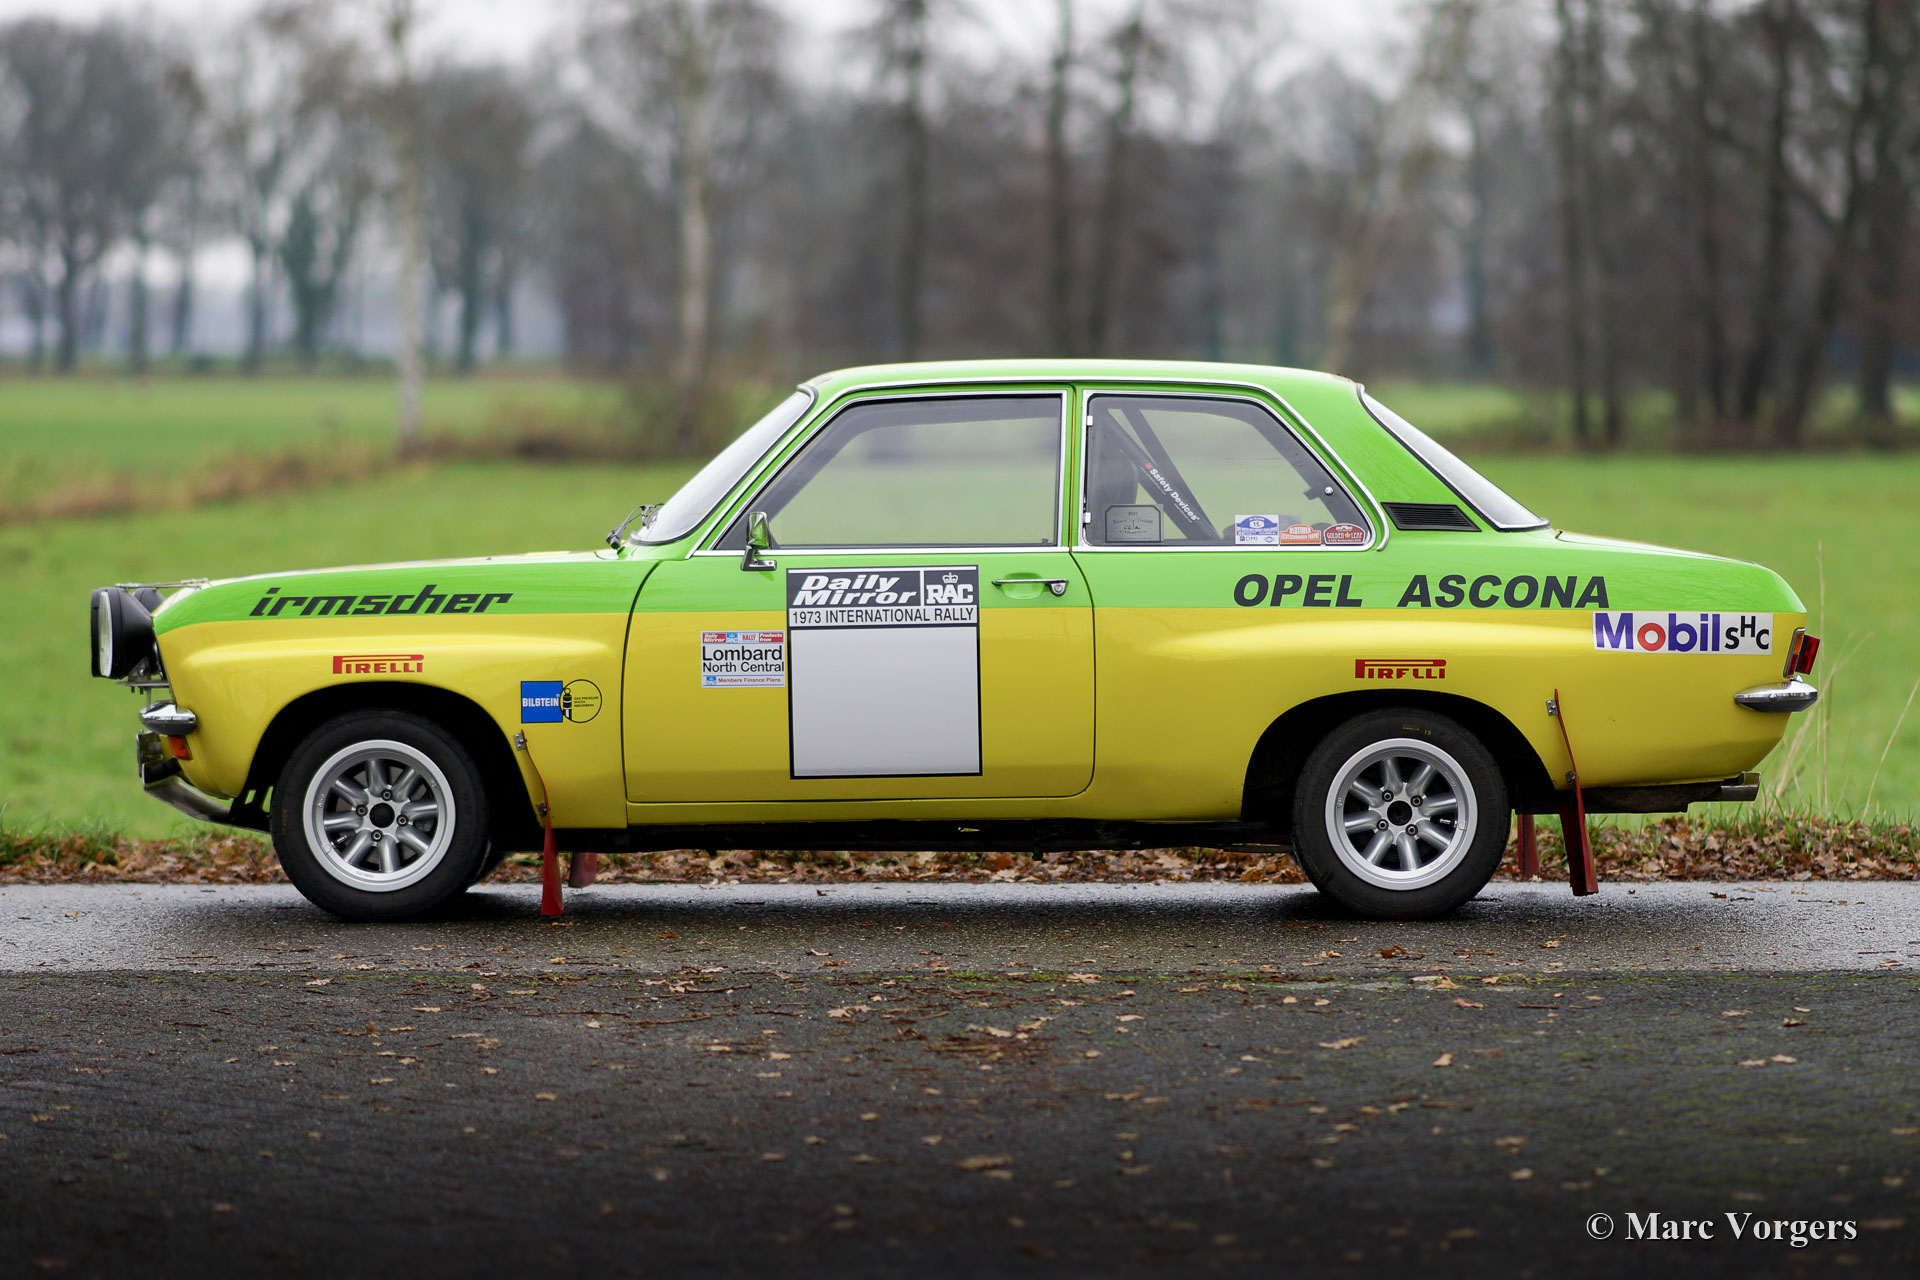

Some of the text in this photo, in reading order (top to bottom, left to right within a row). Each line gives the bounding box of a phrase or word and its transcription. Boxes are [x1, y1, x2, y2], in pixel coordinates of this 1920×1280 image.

[1150, 469, 1172, 491] Safety
[1170, 492, 1198, 520] Devices
[801, 574, 900, 593] Daily
[1233, 574, 1610, 608] OPEL ASCONA
[249, 584, 514, 616] irmscher
[792, 589, 917, 606] Mirror
[926, 584, 974, 604] RAC
[792, 607, 974, 624] 1973 INTERNATIONAL RALLY
[1595, 612, 1720, 652] Mobil
[702, 645, 782, 661] Lombard
[333, 654, 424, 674] PIRELLI
[703, 661, 784, 673] North Central
[522, 697, 559, 707] BILSTEIN
